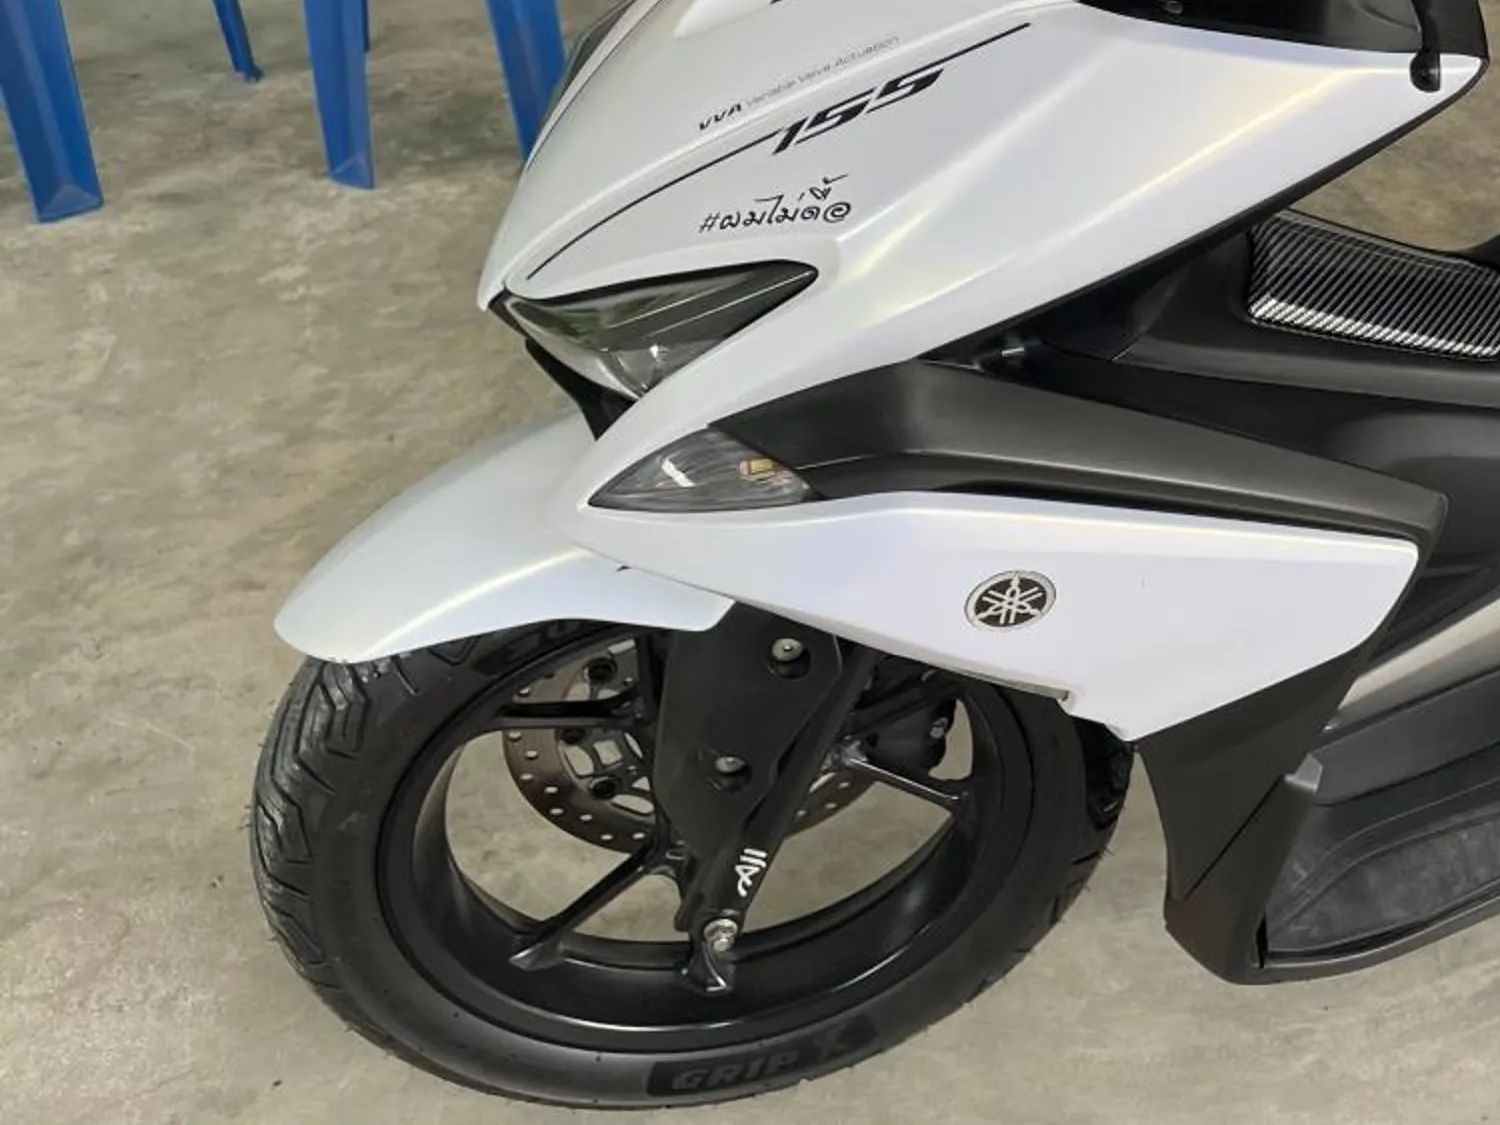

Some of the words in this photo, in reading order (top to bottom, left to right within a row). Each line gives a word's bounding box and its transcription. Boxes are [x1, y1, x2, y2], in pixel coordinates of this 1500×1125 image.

[698, 103, 743, 131] VVA
[771, 63, 945, 155] 155
[671, 1051, 801, 1091] GRIP
